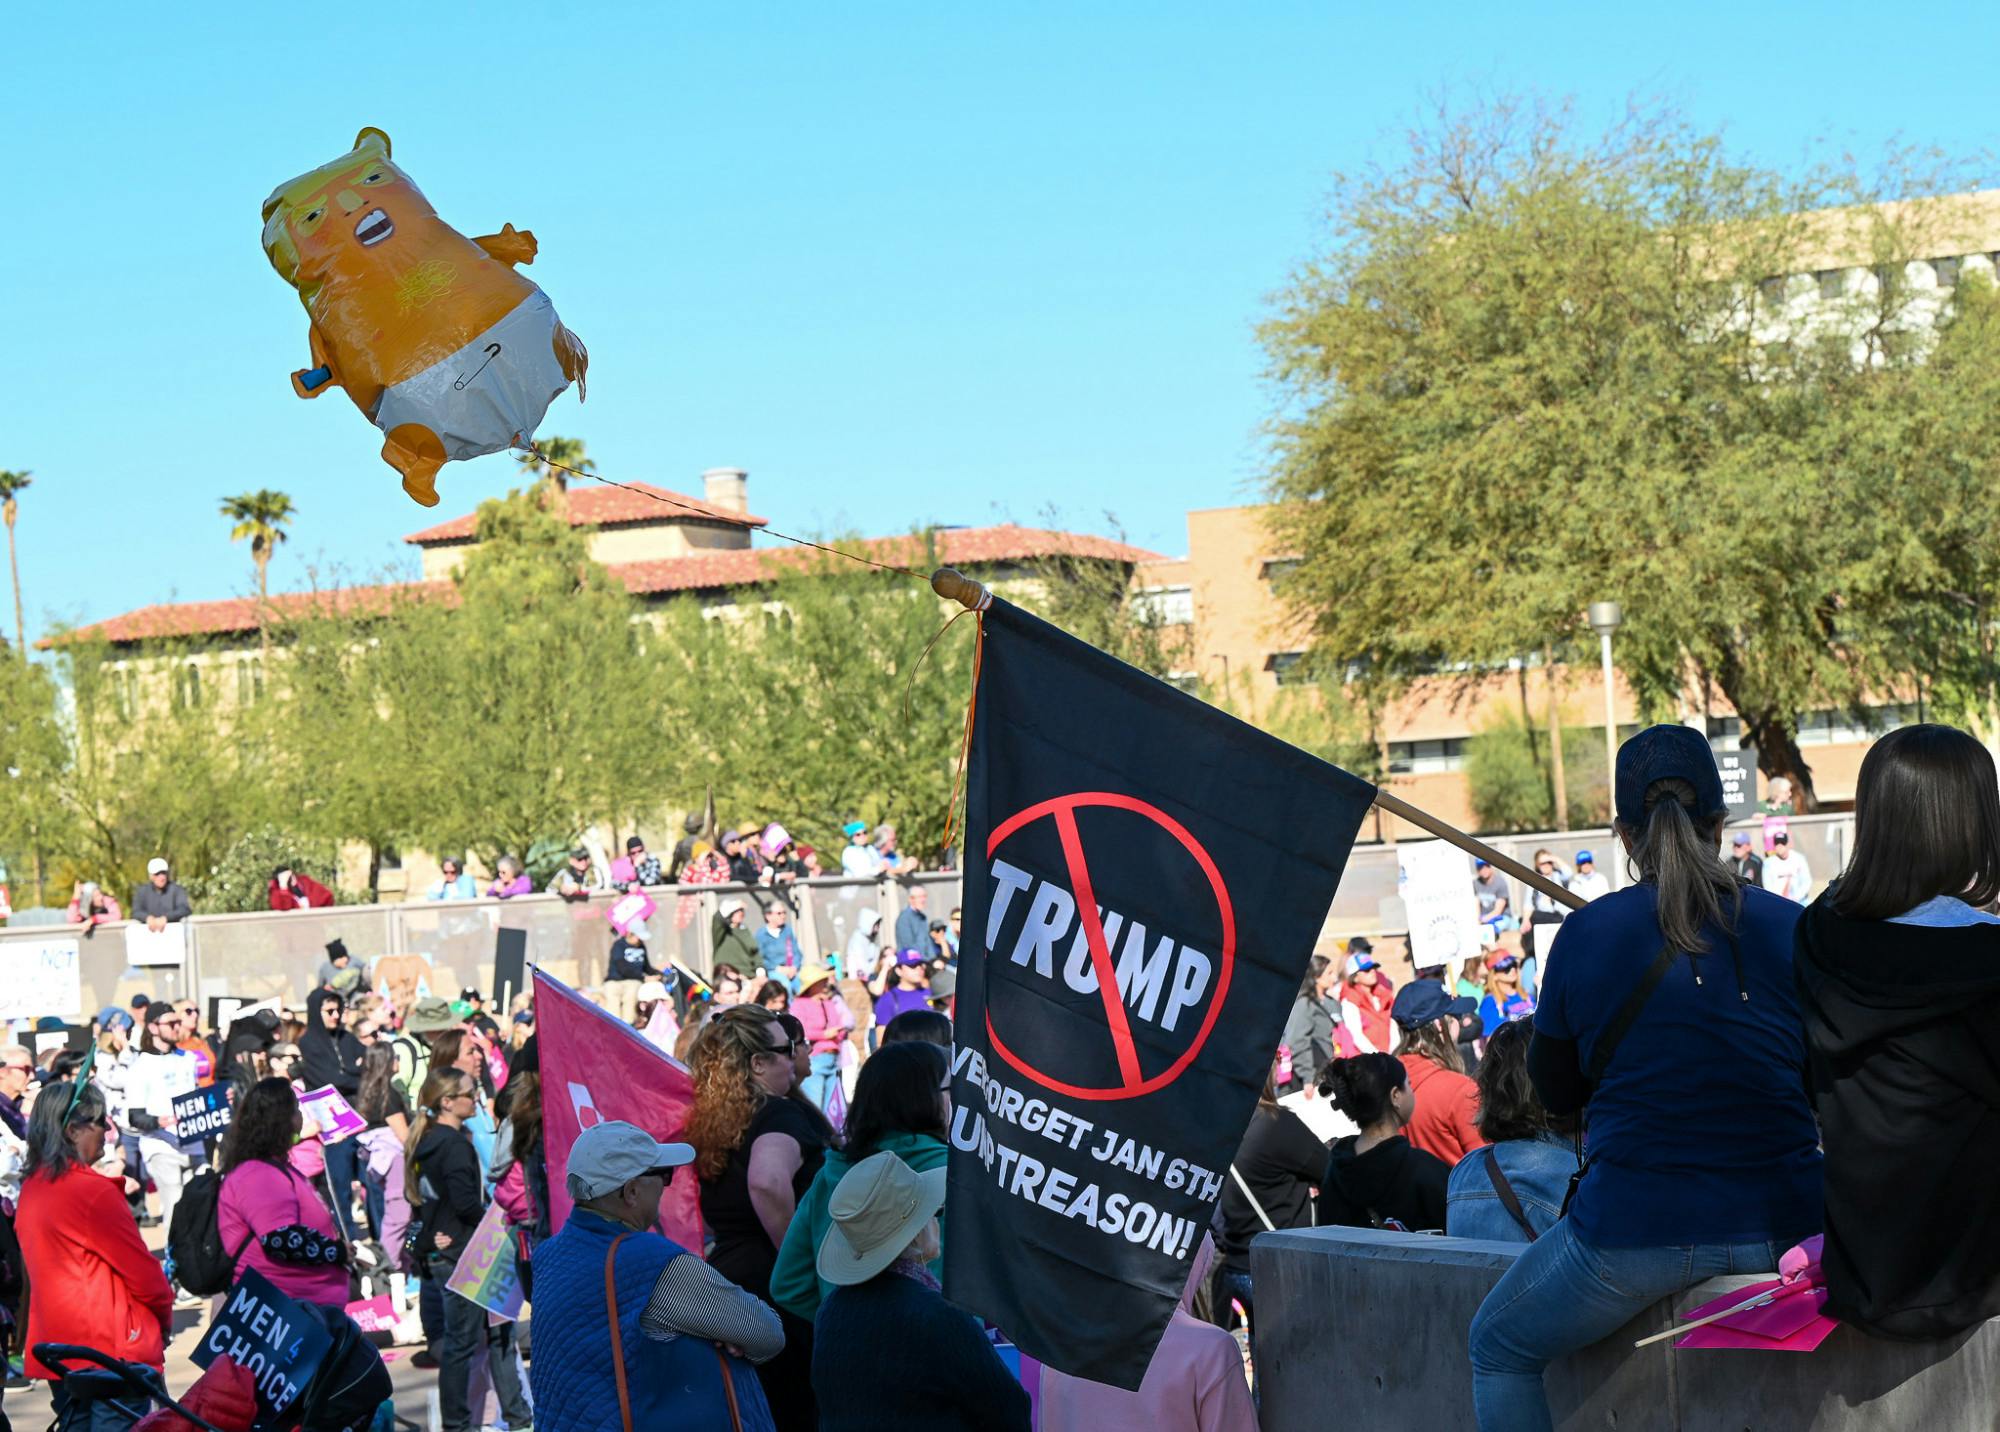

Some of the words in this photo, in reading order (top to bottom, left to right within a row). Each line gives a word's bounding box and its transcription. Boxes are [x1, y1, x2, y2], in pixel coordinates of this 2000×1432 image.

[986, 858, 1212, 1032] TRUMP
[174, 1096, 206, 1120] MEN
[178, 1107, 232, 1138] CHOICE
[997, 1145, 1197, 1260] TREASON!
[1091, 1129, 1165, 1181] JAN
[1165, 1157, 1225, 1203] 6TH
[228, 1286, 291, 1351] MEN
[208, 1324, 297, 1412] CHOICE
